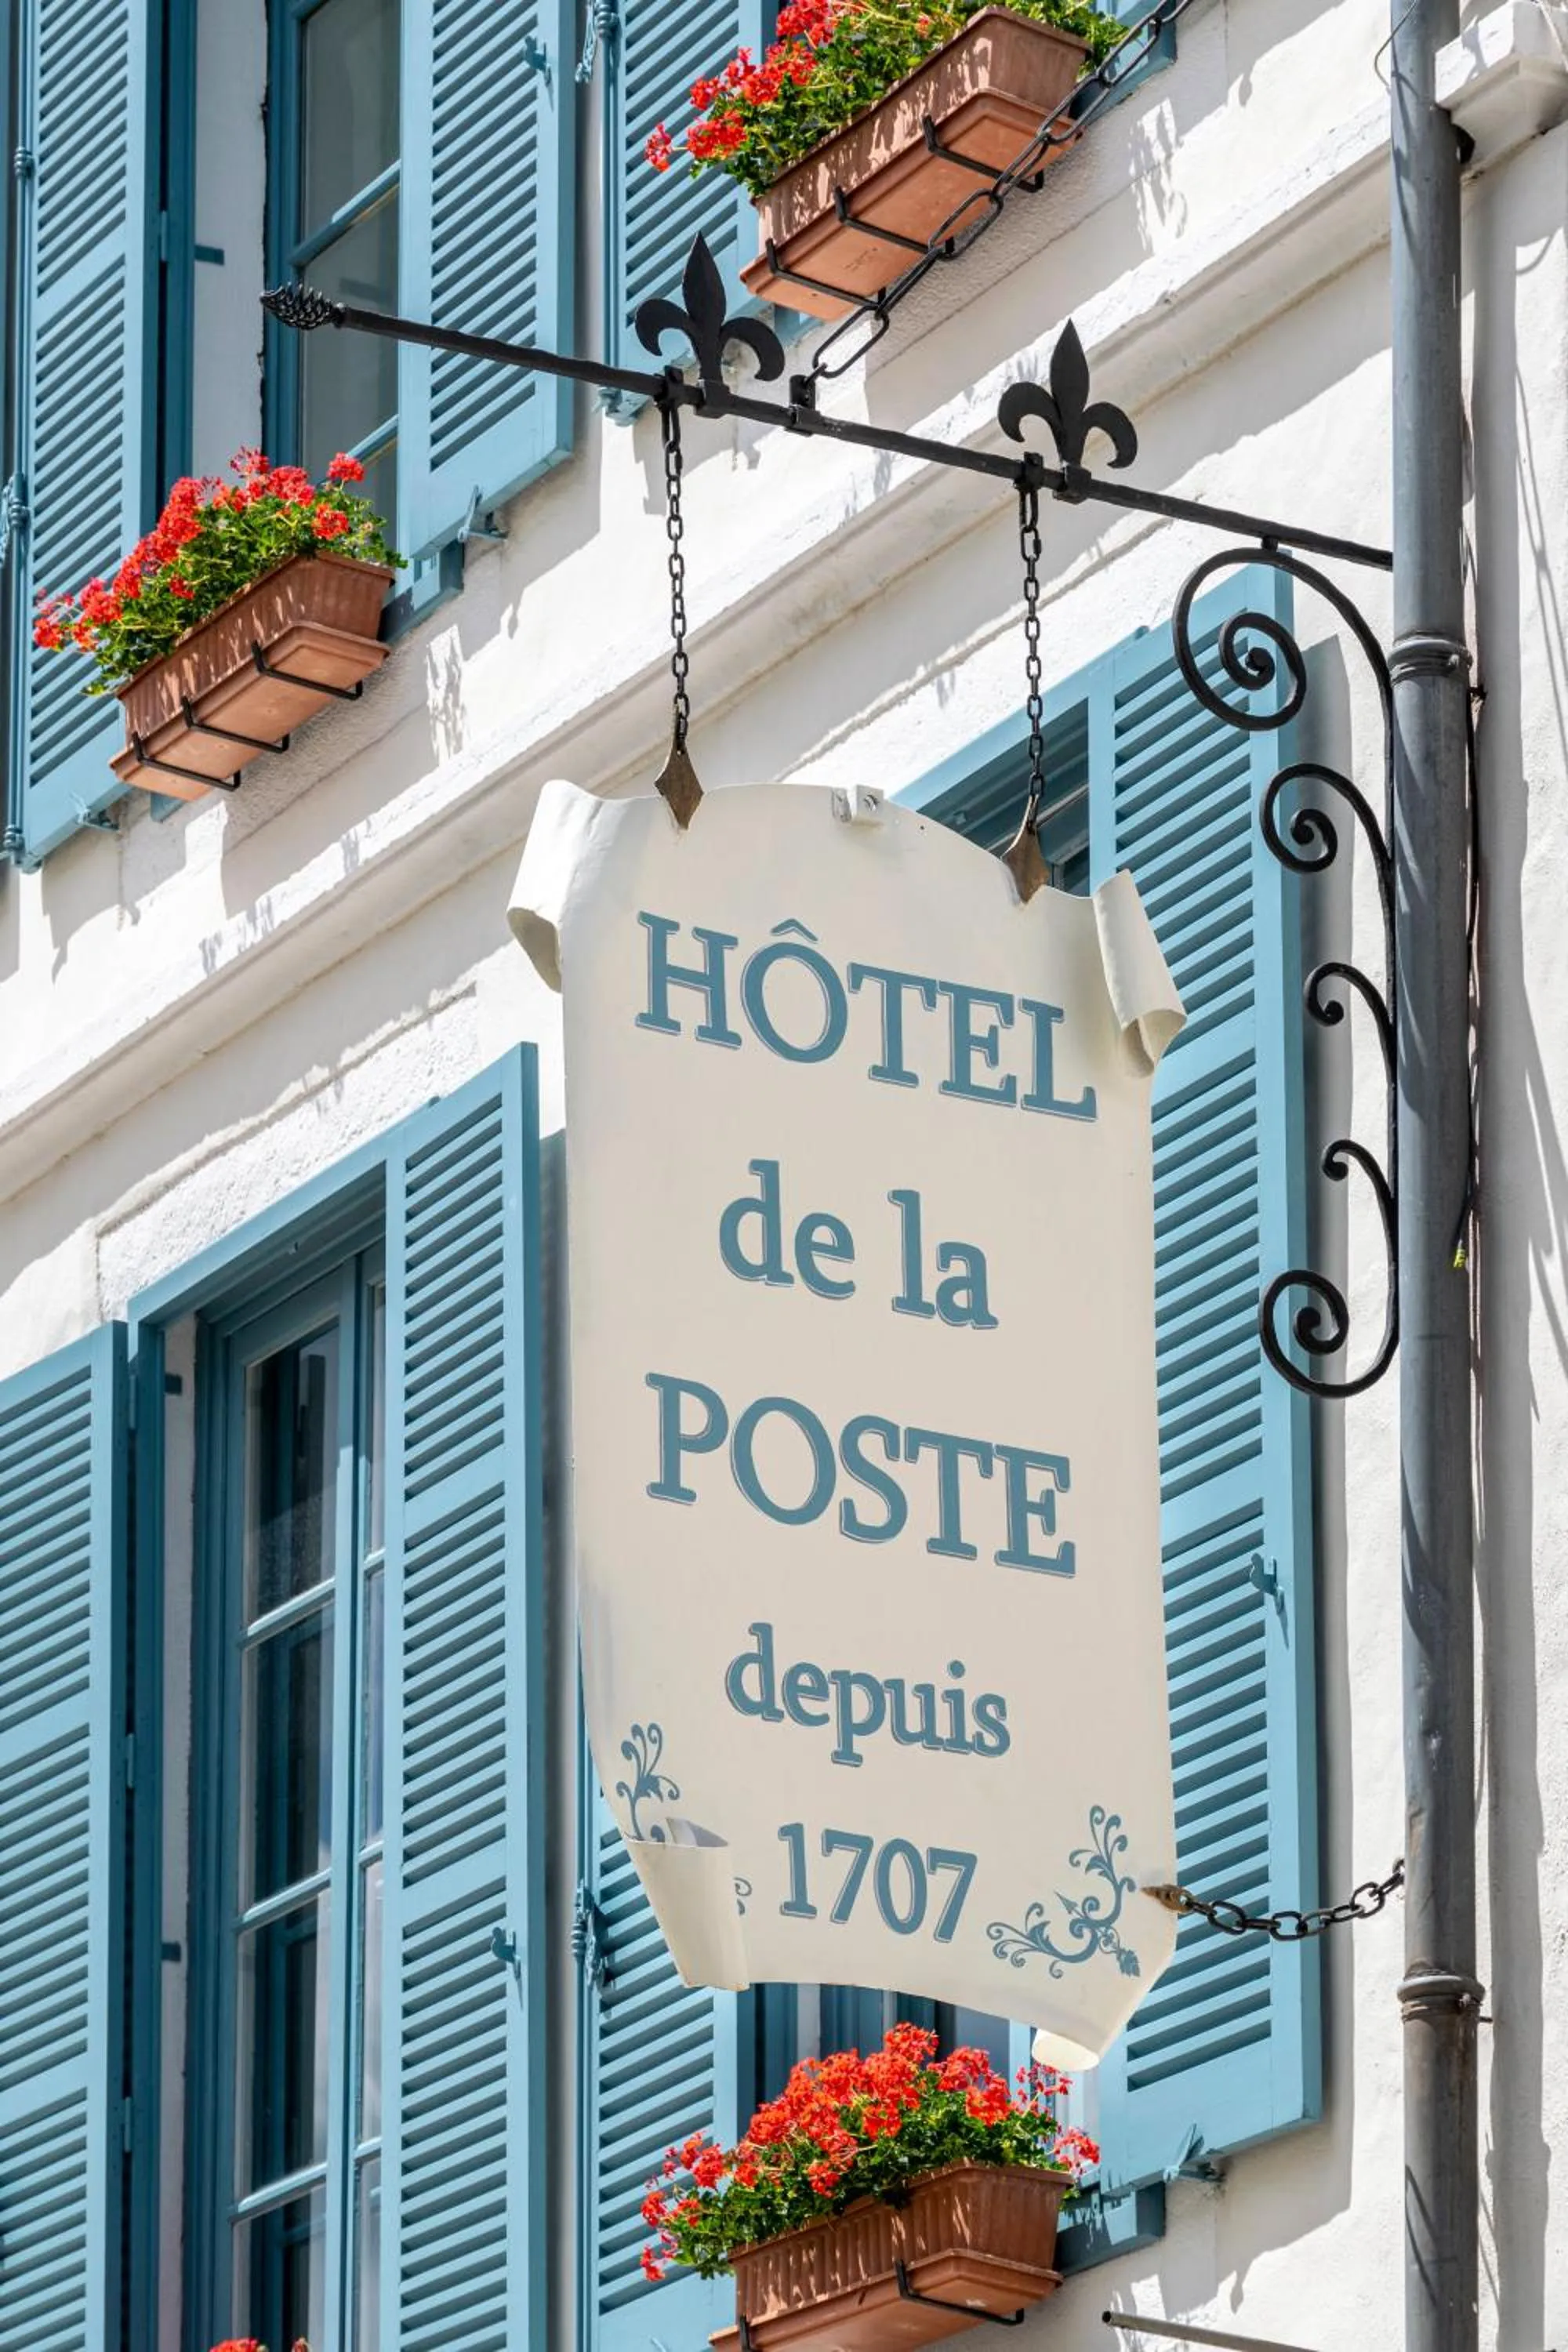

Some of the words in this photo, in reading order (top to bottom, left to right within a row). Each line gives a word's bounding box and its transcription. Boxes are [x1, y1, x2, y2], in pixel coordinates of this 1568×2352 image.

[634, 911, 1098, 1123] HÔTEL
[719, 1158, 856, 1300] de
[887, 1189, 1000, 1330] la
[644, 1372, 1076, 1578] POSTE
[725, 1622, 1011, 1767] depuis
[777, 1822, 978, 1944] 1707
